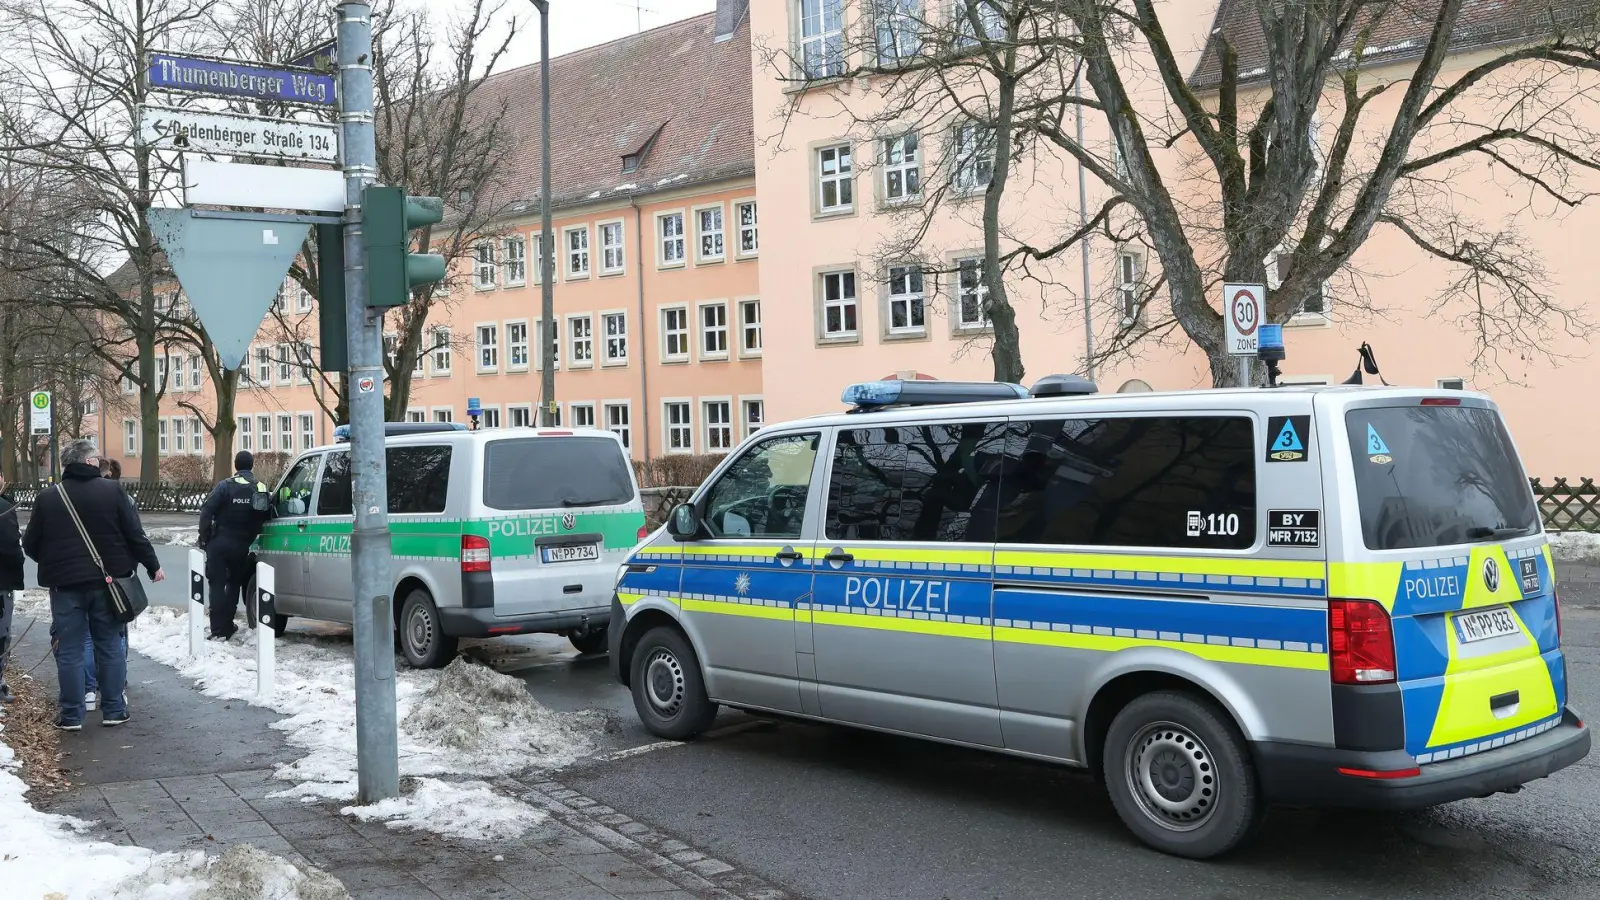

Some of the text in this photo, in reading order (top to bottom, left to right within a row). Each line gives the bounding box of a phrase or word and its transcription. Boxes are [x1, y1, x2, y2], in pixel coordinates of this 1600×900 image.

[158, 58, 284, 95] Thumenberger
[292, 74, 326, 101] Weg
[263, 130, 303, 149] Straße
[309, 134, 330, 151] 134
[1237, 302, 1253, 323] 30
[1236, 338, 1257, 350] ZONE
[1281, 430, 1293, 447] 3
[1370, 434, 1381, 451] 3
[488, 518, 558, 537] POLIZEI
[1207, 513, 1239, 536] 110
[1282, 513, 1304, 526] BY
[1269, 530, 1317, 543] MFR 7132
[564, 548, 575, 559] PP
[577, 546, 594, 557] 734
[845, 576, 951, 613] POLIZEI
[1405, 575, 1460, 600] POLIZEI
[1476, 614, 1493, 635] PP
